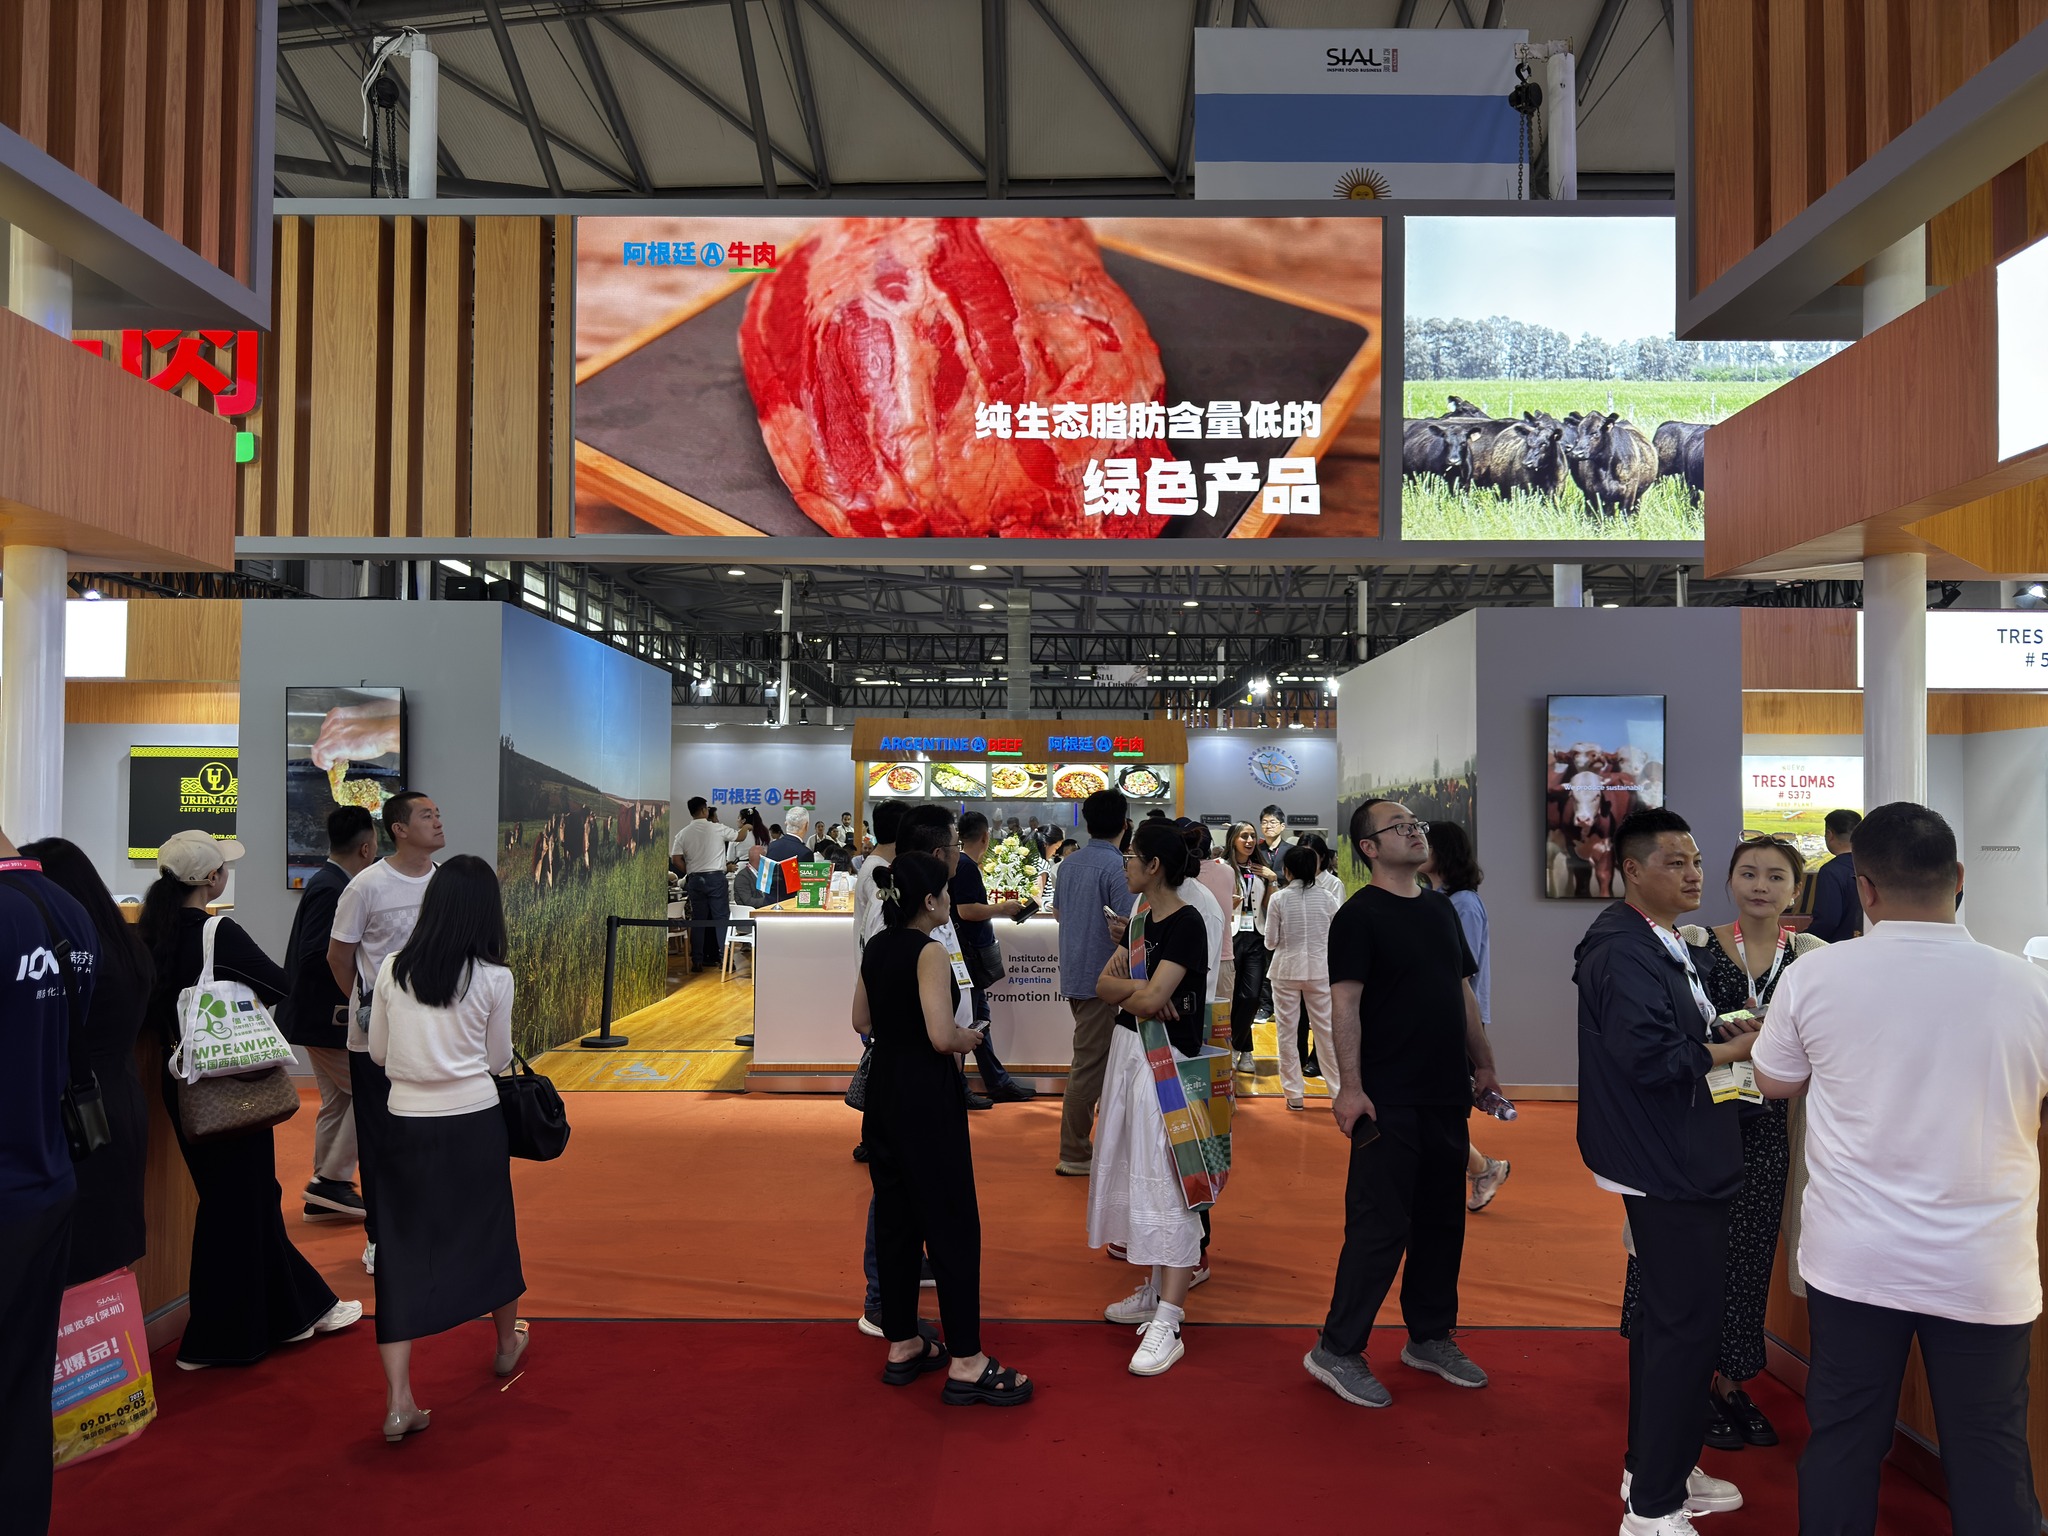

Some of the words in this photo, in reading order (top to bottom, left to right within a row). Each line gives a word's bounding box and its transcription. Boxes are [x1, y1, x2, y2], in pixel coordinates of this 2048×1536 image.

[1327, 48, 1382, 66] SIAL
[623, 241, 696, 266] 阿根廷
[728, 241, 776, 267] 牛肉
[974, 401, 1321, 439] 纯生态脂肪含量低的
[1083, 456, 1320, 517] 绿色产品
[1996, 629, 2044, 644] TRES
[880, 736, 969, 752] ARGENTINE
[987, 739, 1022, 752] BEEF
[1048, 736, 1094, 752] 阿根廷
[1113, 736, 1144, 752] 牛肉
[1575, 784, 1605, 792] produce
[1606, 784, 1645, 792] sustainably
[1752, 775, 1786, 788] TRES
[1791, 775, 1835, 788] LOMAS
[712, 788, 761, 805] 阿根廷
[783, 788, 816, 805] 牛肉
[1788, 791, 1811, 799] 5373
[1008, 954, 1046, 962] Instituto
[1047, 954, 1058, 962] de
[1008, 965, 1019, 973] de
[1021, 965, 1029, 973] la
[1031, 965, 1057, 973] Carne
[1008, 976, 1052, 985] Argentina
[986, 991, 1050, 1002] Promotion
